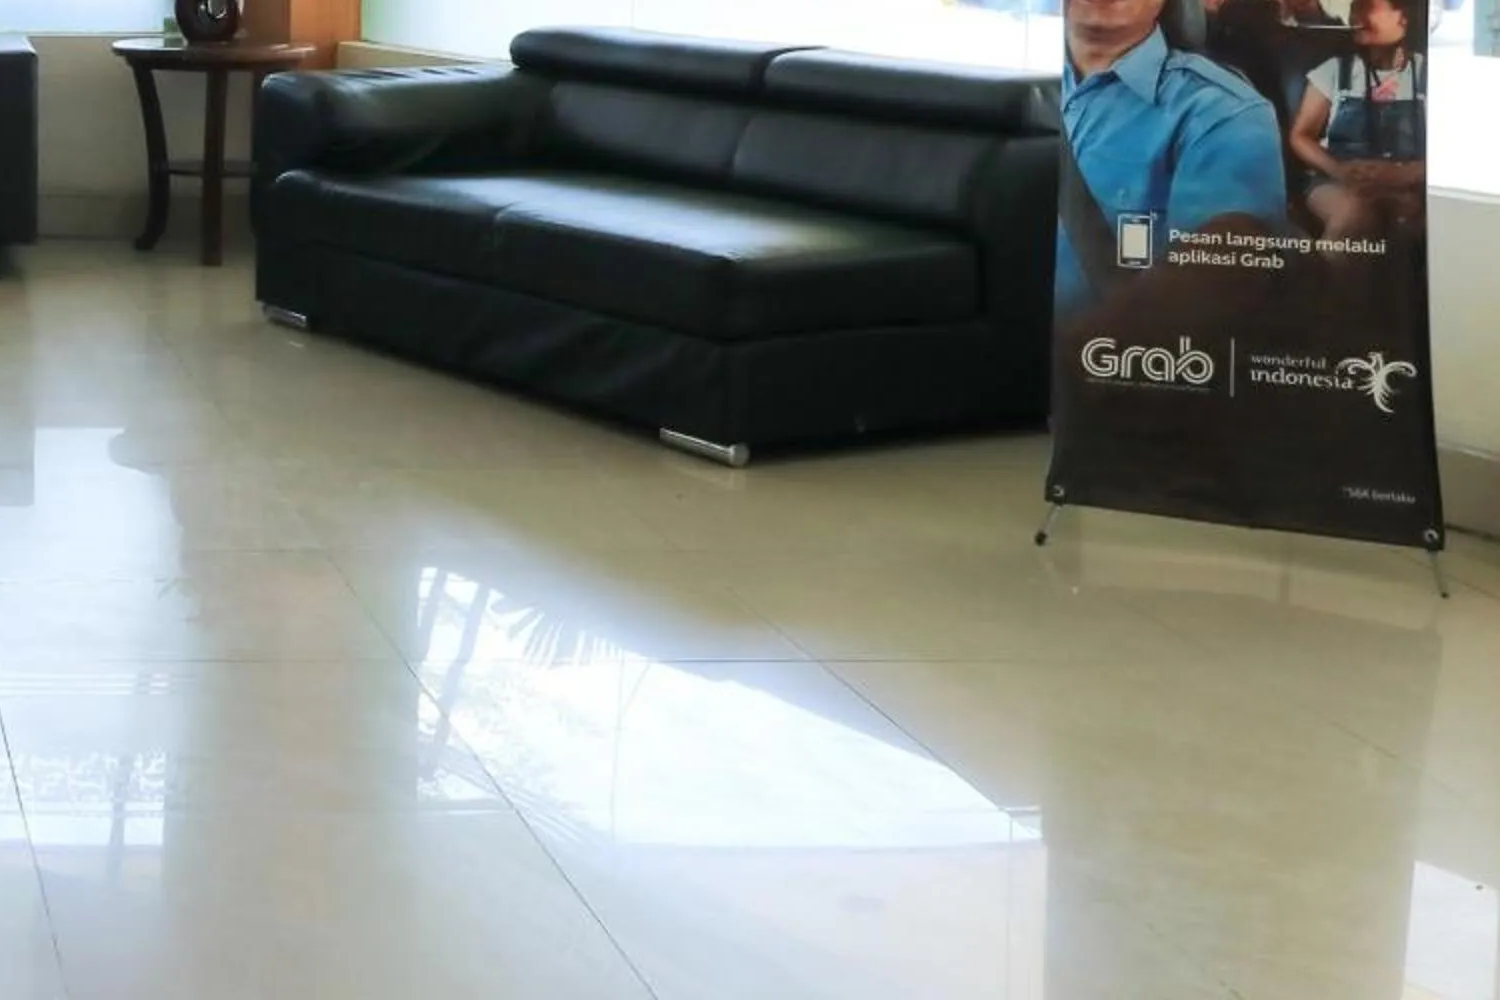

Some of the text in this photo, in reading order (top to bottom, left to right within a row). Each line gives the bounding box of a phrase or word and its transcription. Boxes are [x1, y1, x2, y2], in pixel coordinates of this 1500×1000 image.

[1169, 229, 1387, 254] Pesan langsung melalui
[1168, 250, 1285, 269] aplikasi Grab
[1082, 335, 1214, 384] Grab
[1250, 354, 1327, 370] wonderful
